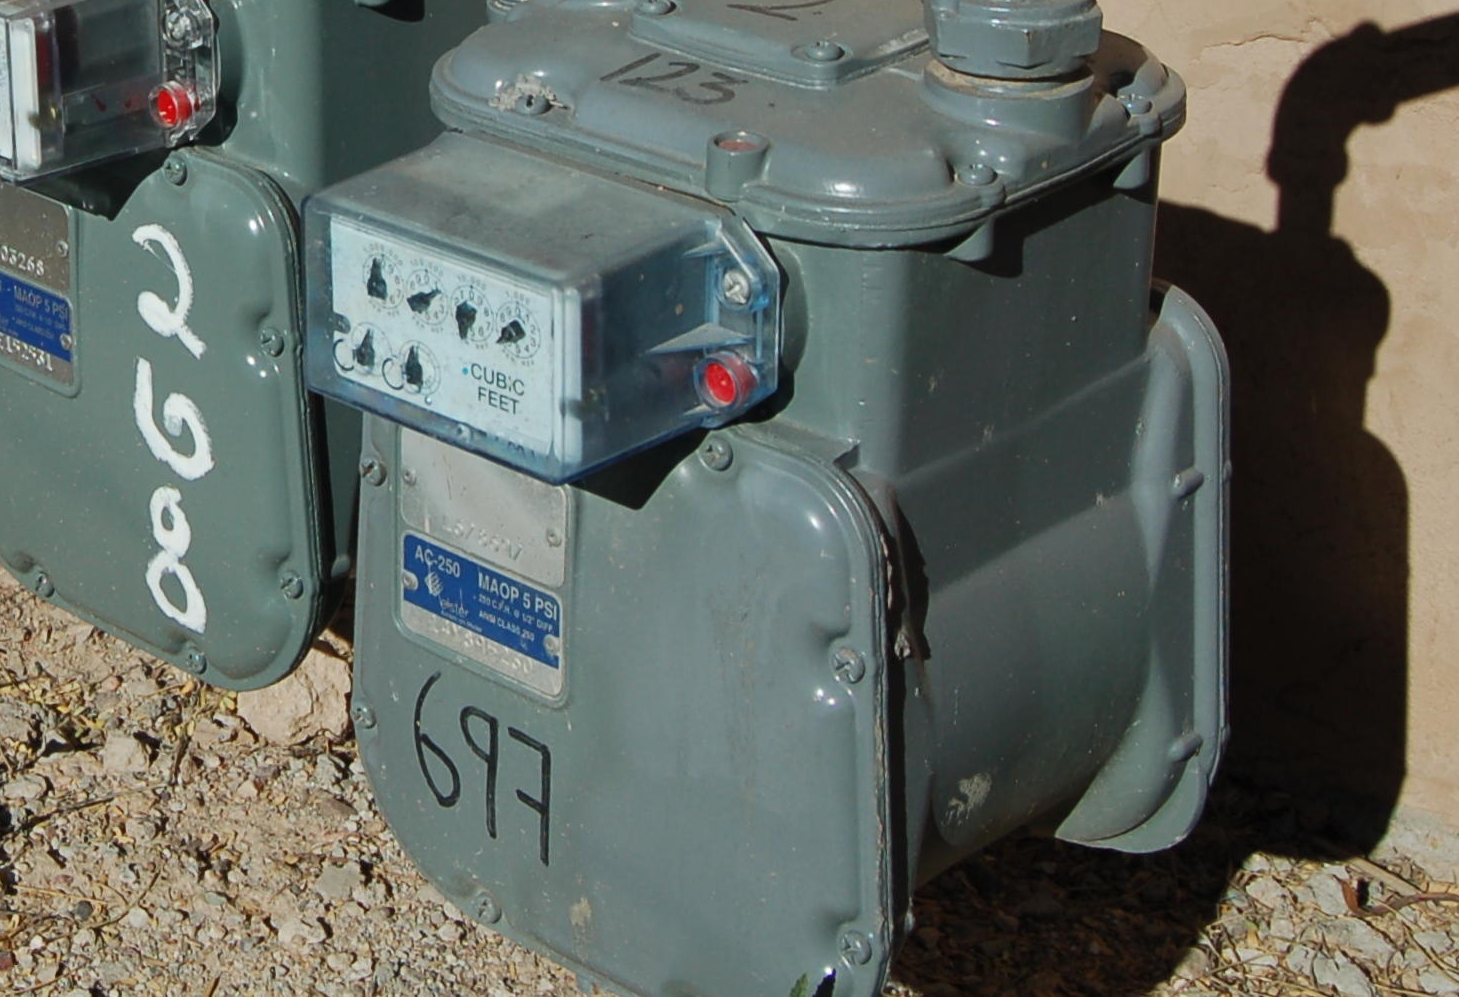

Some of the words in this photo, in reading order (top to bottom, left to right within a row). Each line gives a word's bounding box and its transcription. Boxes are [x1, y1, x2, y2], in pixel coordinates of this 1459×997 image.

[470, 363, 525, 396] CUBIC
[478, 386, 519, 414] FEET
[414, 545, 460, 578] AC-250
[478, 572, 519, 602] MAOP
[523, 593, 531, 609] 5
[535, 597, 557, 621] PSI
[413, 670, 552, 867] 697
